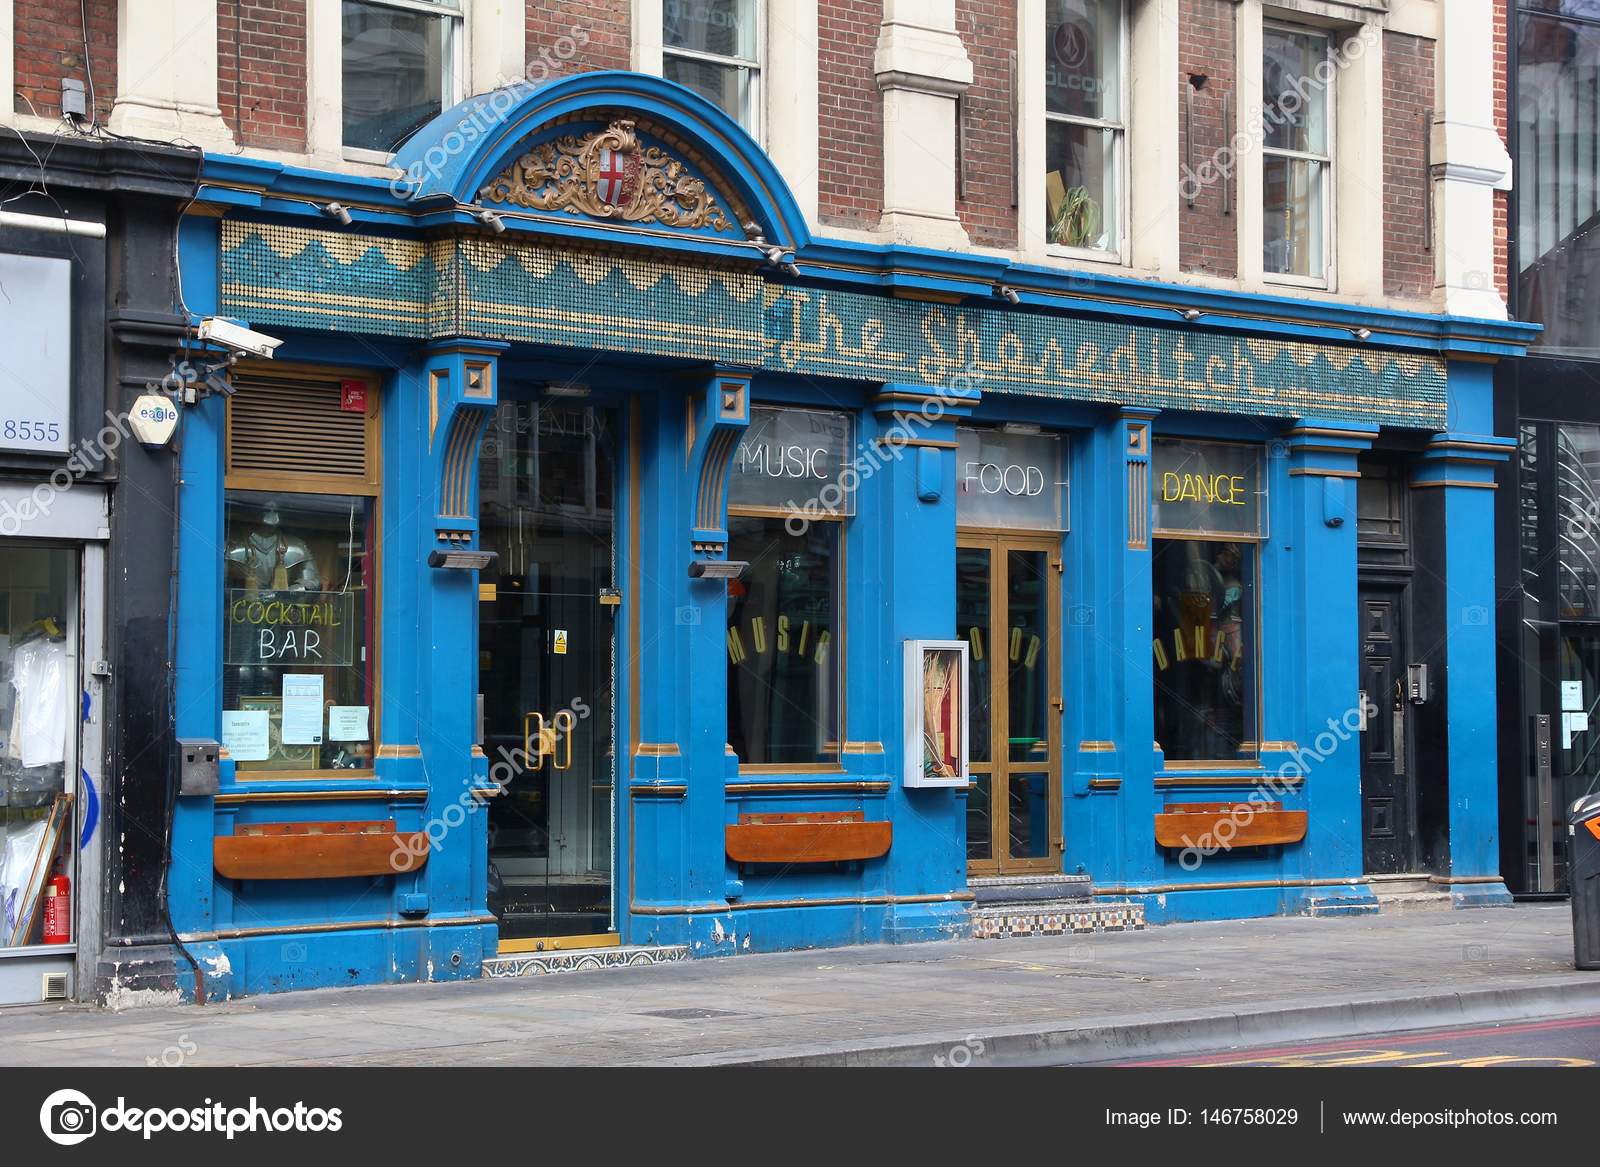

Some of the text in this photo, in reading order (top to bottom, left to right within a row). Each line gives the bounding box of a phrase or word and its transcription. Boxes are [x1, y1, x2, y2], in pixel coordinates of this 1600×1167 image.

[1046, 70, 1112, 95] OLCOM
[780, 288, 1276, 396] The Shoreditch
[3, 419, 60, 443] 8555
[140, 406, 177, 423] eagle
[740, 442, 828, 479] MUSIC
[964, 461, 1044, 497] FOOD
[1162, 472, 1246, 505] DANCE
[231, 599, 342, 628] COCKTAIL
[259, 628, 323, 659] BAR
[957, 626, 1041, 670] OOD
[49, 897, 57, 936] VICTORY
